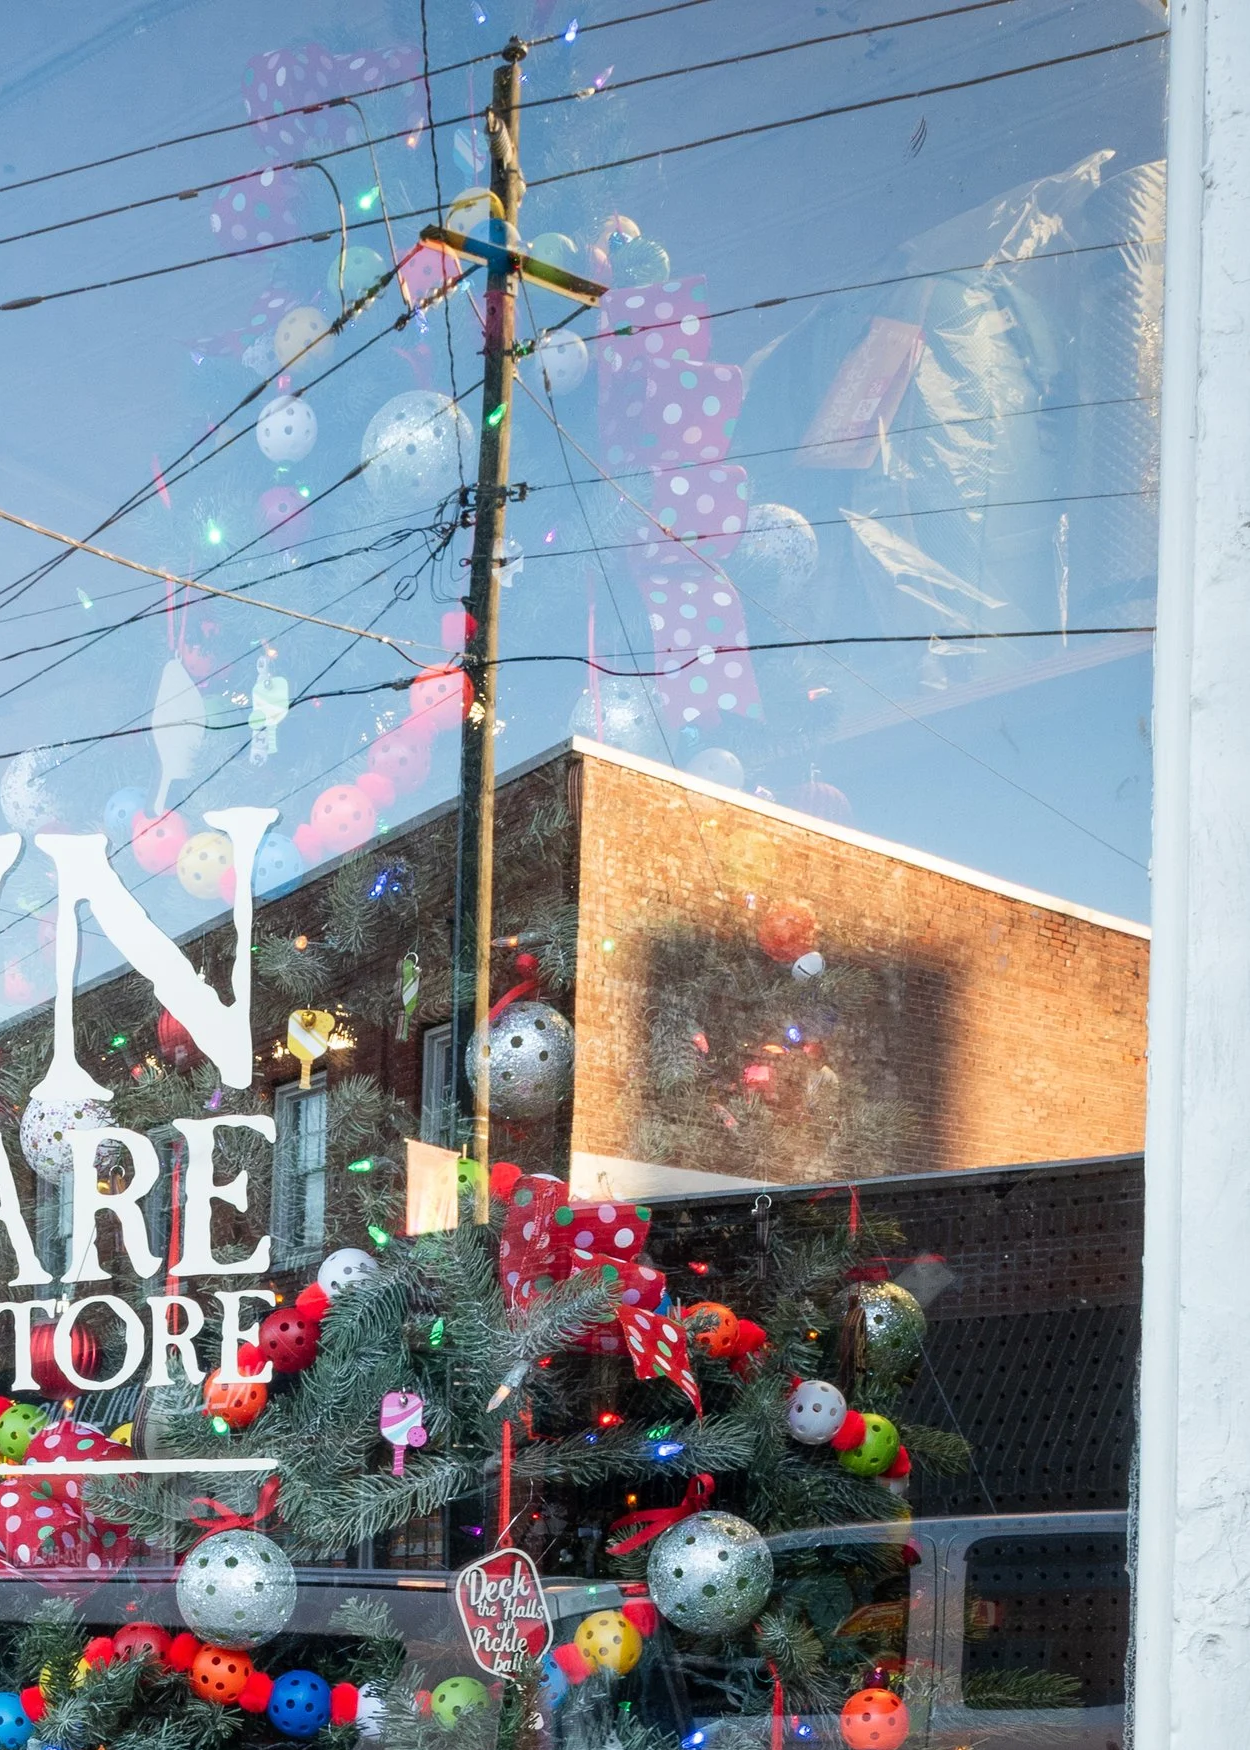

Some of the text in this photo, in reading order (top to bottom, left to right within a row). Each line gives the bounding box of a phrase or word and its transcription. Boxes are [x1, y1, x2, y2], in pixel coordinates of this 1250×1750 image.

[465, 1561, 530, 1606] Deck
[477, 1598, 545, 1620] the Halls
[474, 1625, 529, 1653] Pickle
